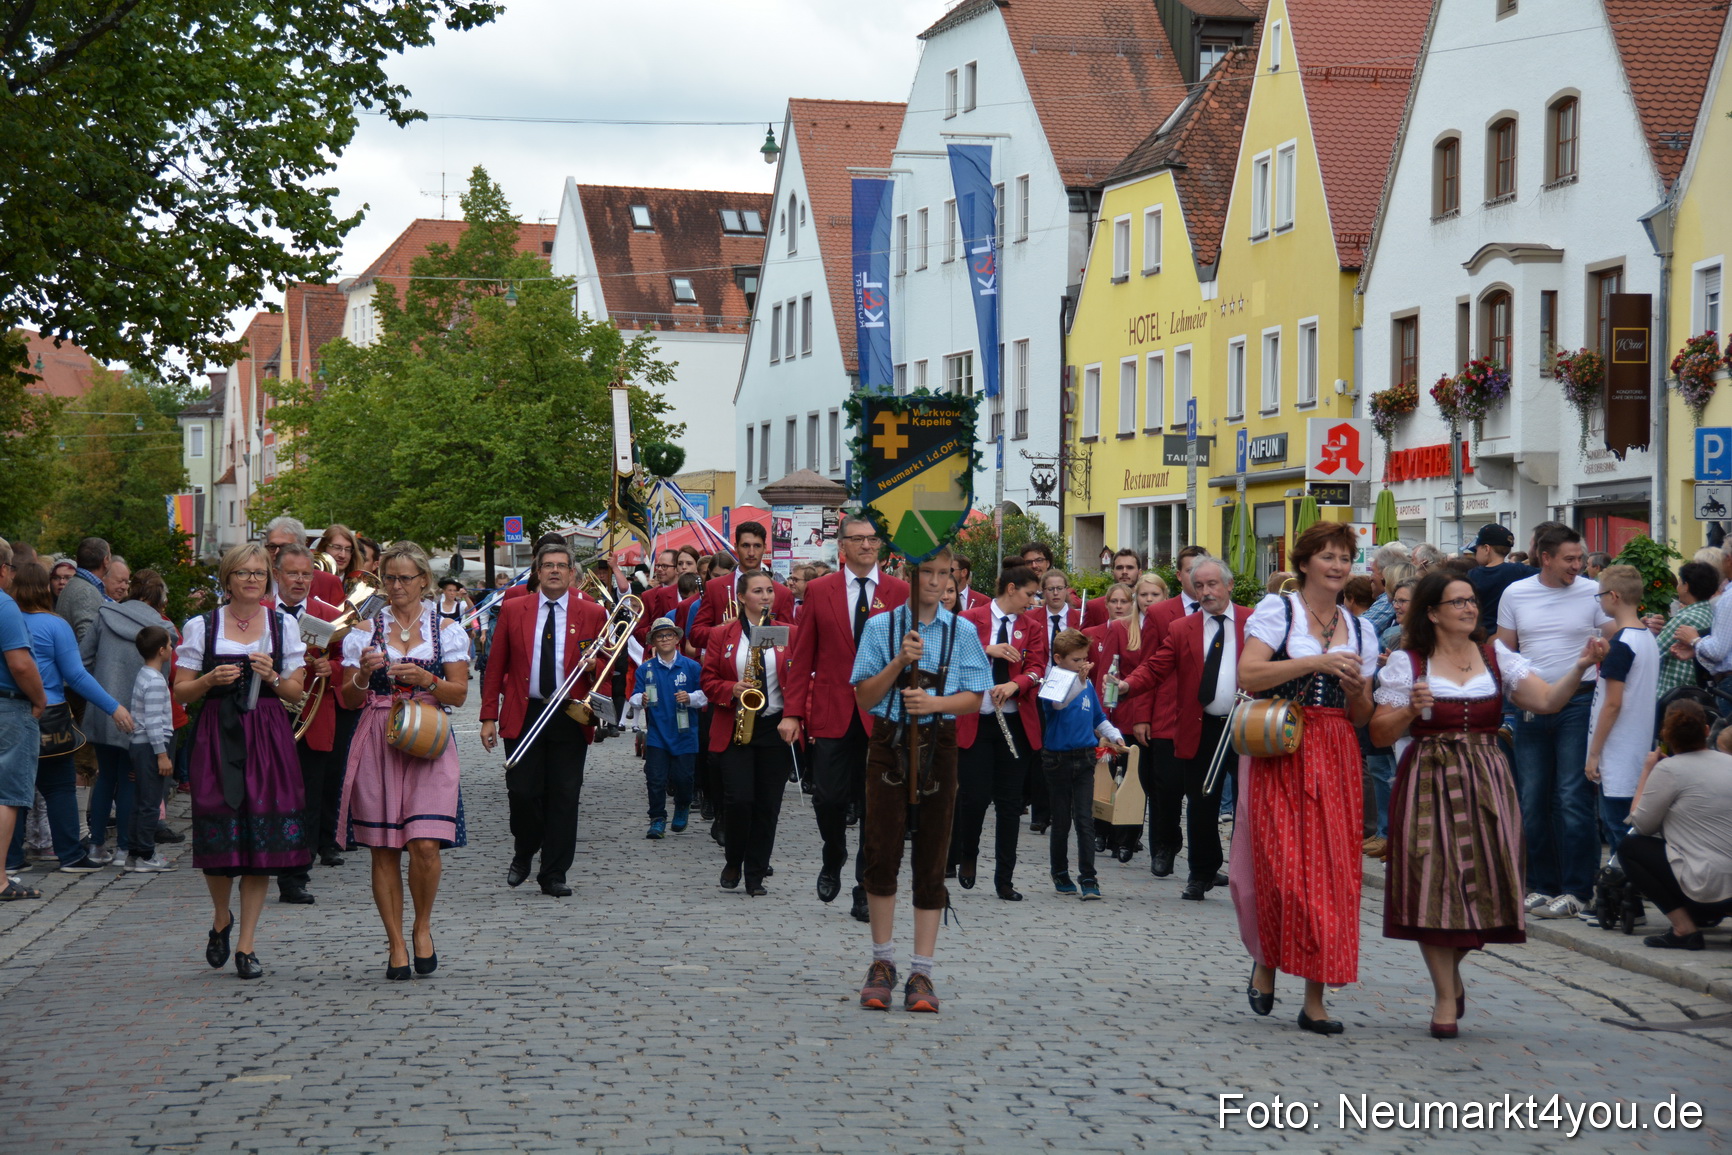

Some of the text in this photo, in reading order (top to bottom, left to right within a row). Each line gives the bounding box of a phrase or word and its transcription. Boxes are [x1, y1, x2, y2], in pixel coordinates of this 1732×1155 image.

[972, 235, 997, 295] K&L
[1129, 305, 1207, 346] HOTEL Lehmeier
[912, 417, 952, 428] Kapelle
[1246, 437, 1279, 459] TAIFUN
[1703, 434, 1724, 475] P
[877, 459, 925, 490] Neumarkt
[1123, 469, 1170, 491] Restaurant
[1399, 505, 1421, 515] APOTHEKE
[1466, 499, 1489, 509] APOTHEKE
